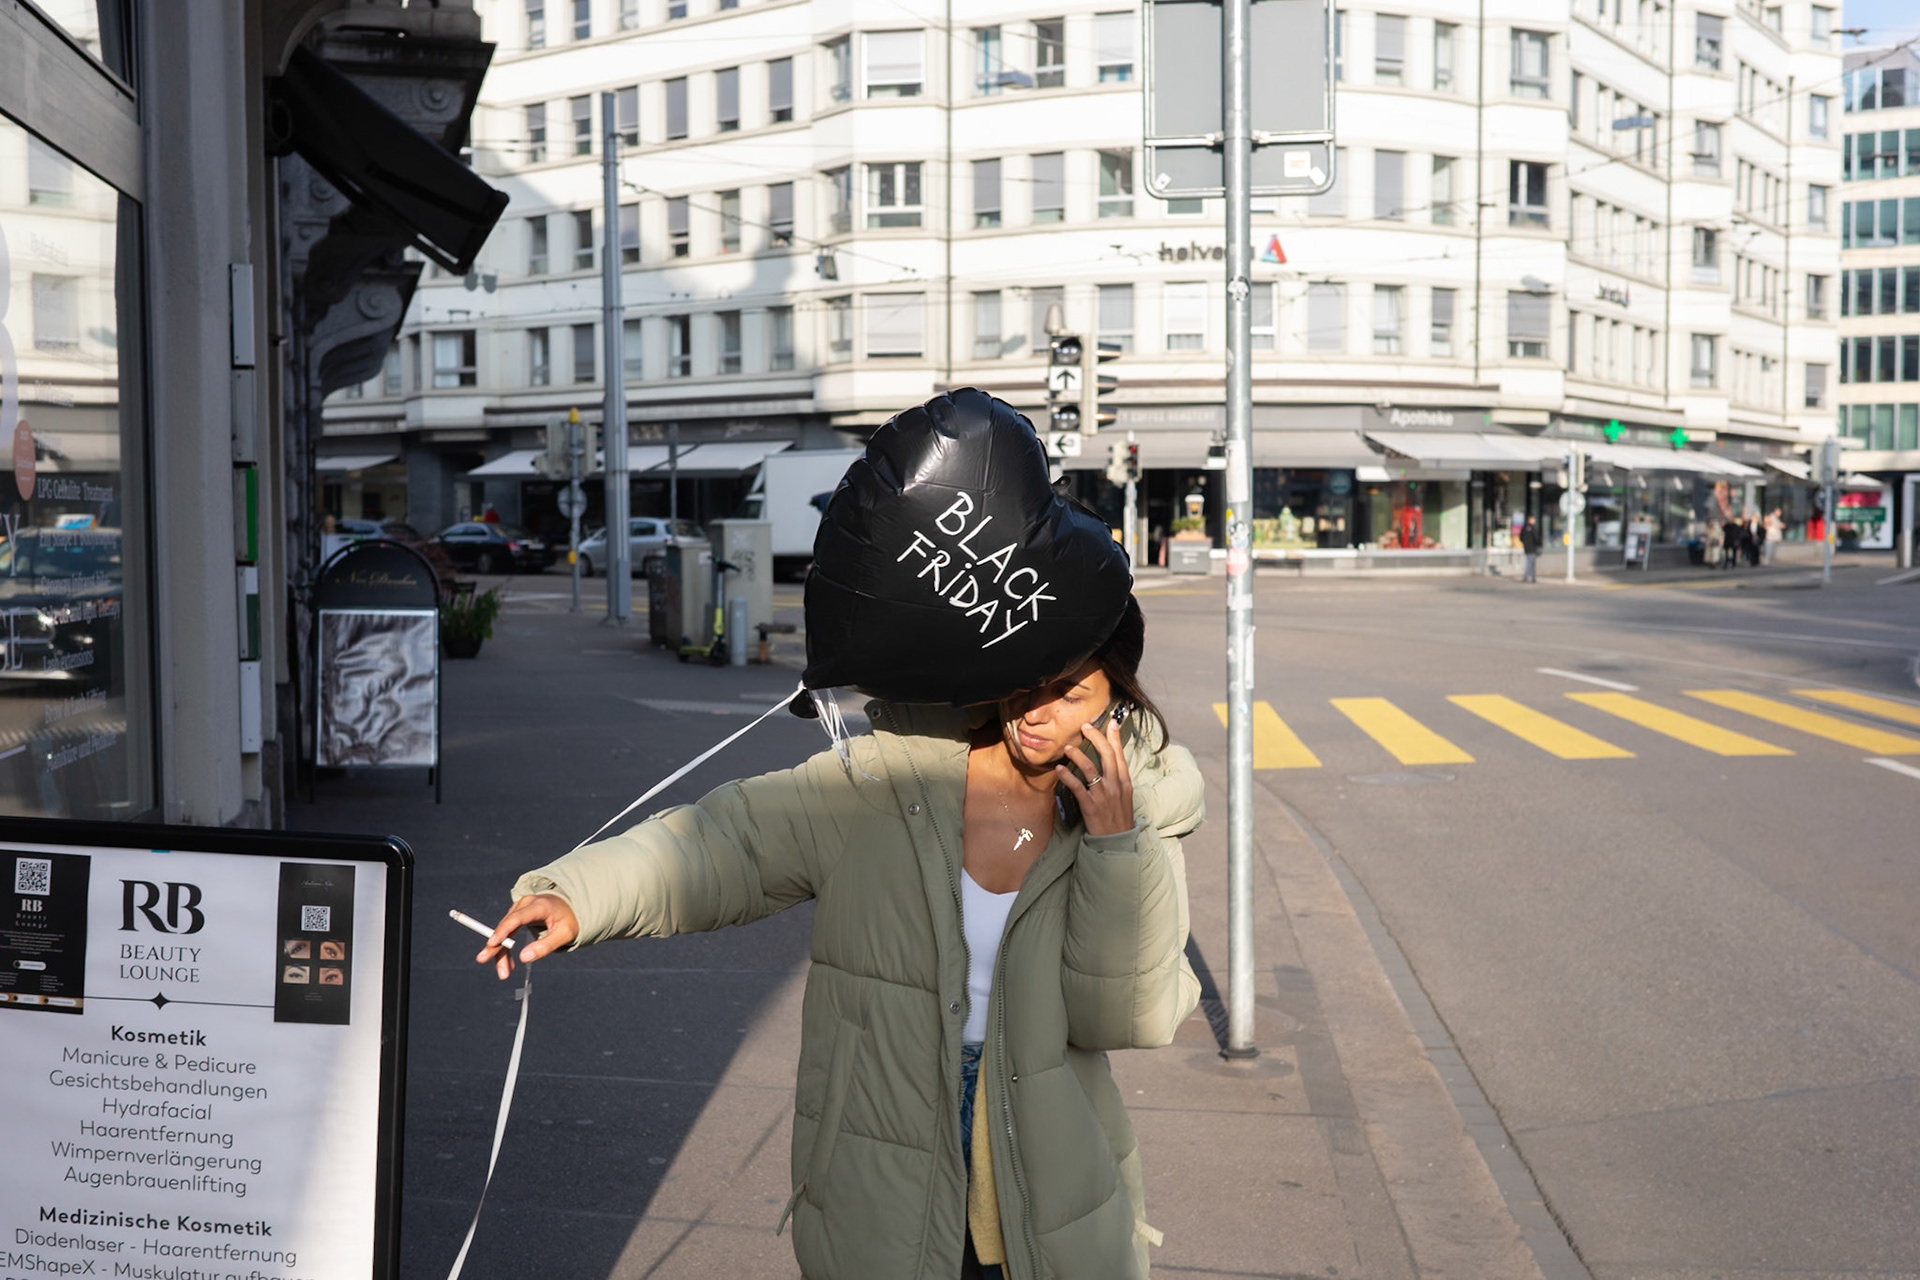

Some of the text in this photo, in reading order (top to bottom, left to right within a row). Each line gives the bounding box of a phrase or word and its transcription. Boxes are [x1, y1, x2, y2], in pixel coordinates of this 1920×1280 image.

[1390, 408, 1454, 428] Apotheke
[935, 491, 1057, 621] BLACK
[21, 898, 43, 912] RB
[118, 879, 206, 935] RB
[120, 943, 202, 962] BEAUTY
[119, 964, 200, 983] LOUNGE
[111, 1024, 207, 1047] Kosmetik
[62, 1046, 257, 1075] Manicure & Pedicure
[49, 1070, 268, 1102] Gesichtsbehandlungen
[102, 1097, 212, 1121] Hydrafacial
[80, 1119, 234, 1149] Haarentfernung
[50, 1140, 262, 1175] Wimpernverlängerung
[63, 1165, 247, 1198] Augenbrauenlifting
[39, 1205, 273, 1237] Medizinische Kosmetik
[15, 1228, 125, 1253] Diodenlaser
[143, 1239, 297, 1268] Haarentfernung
